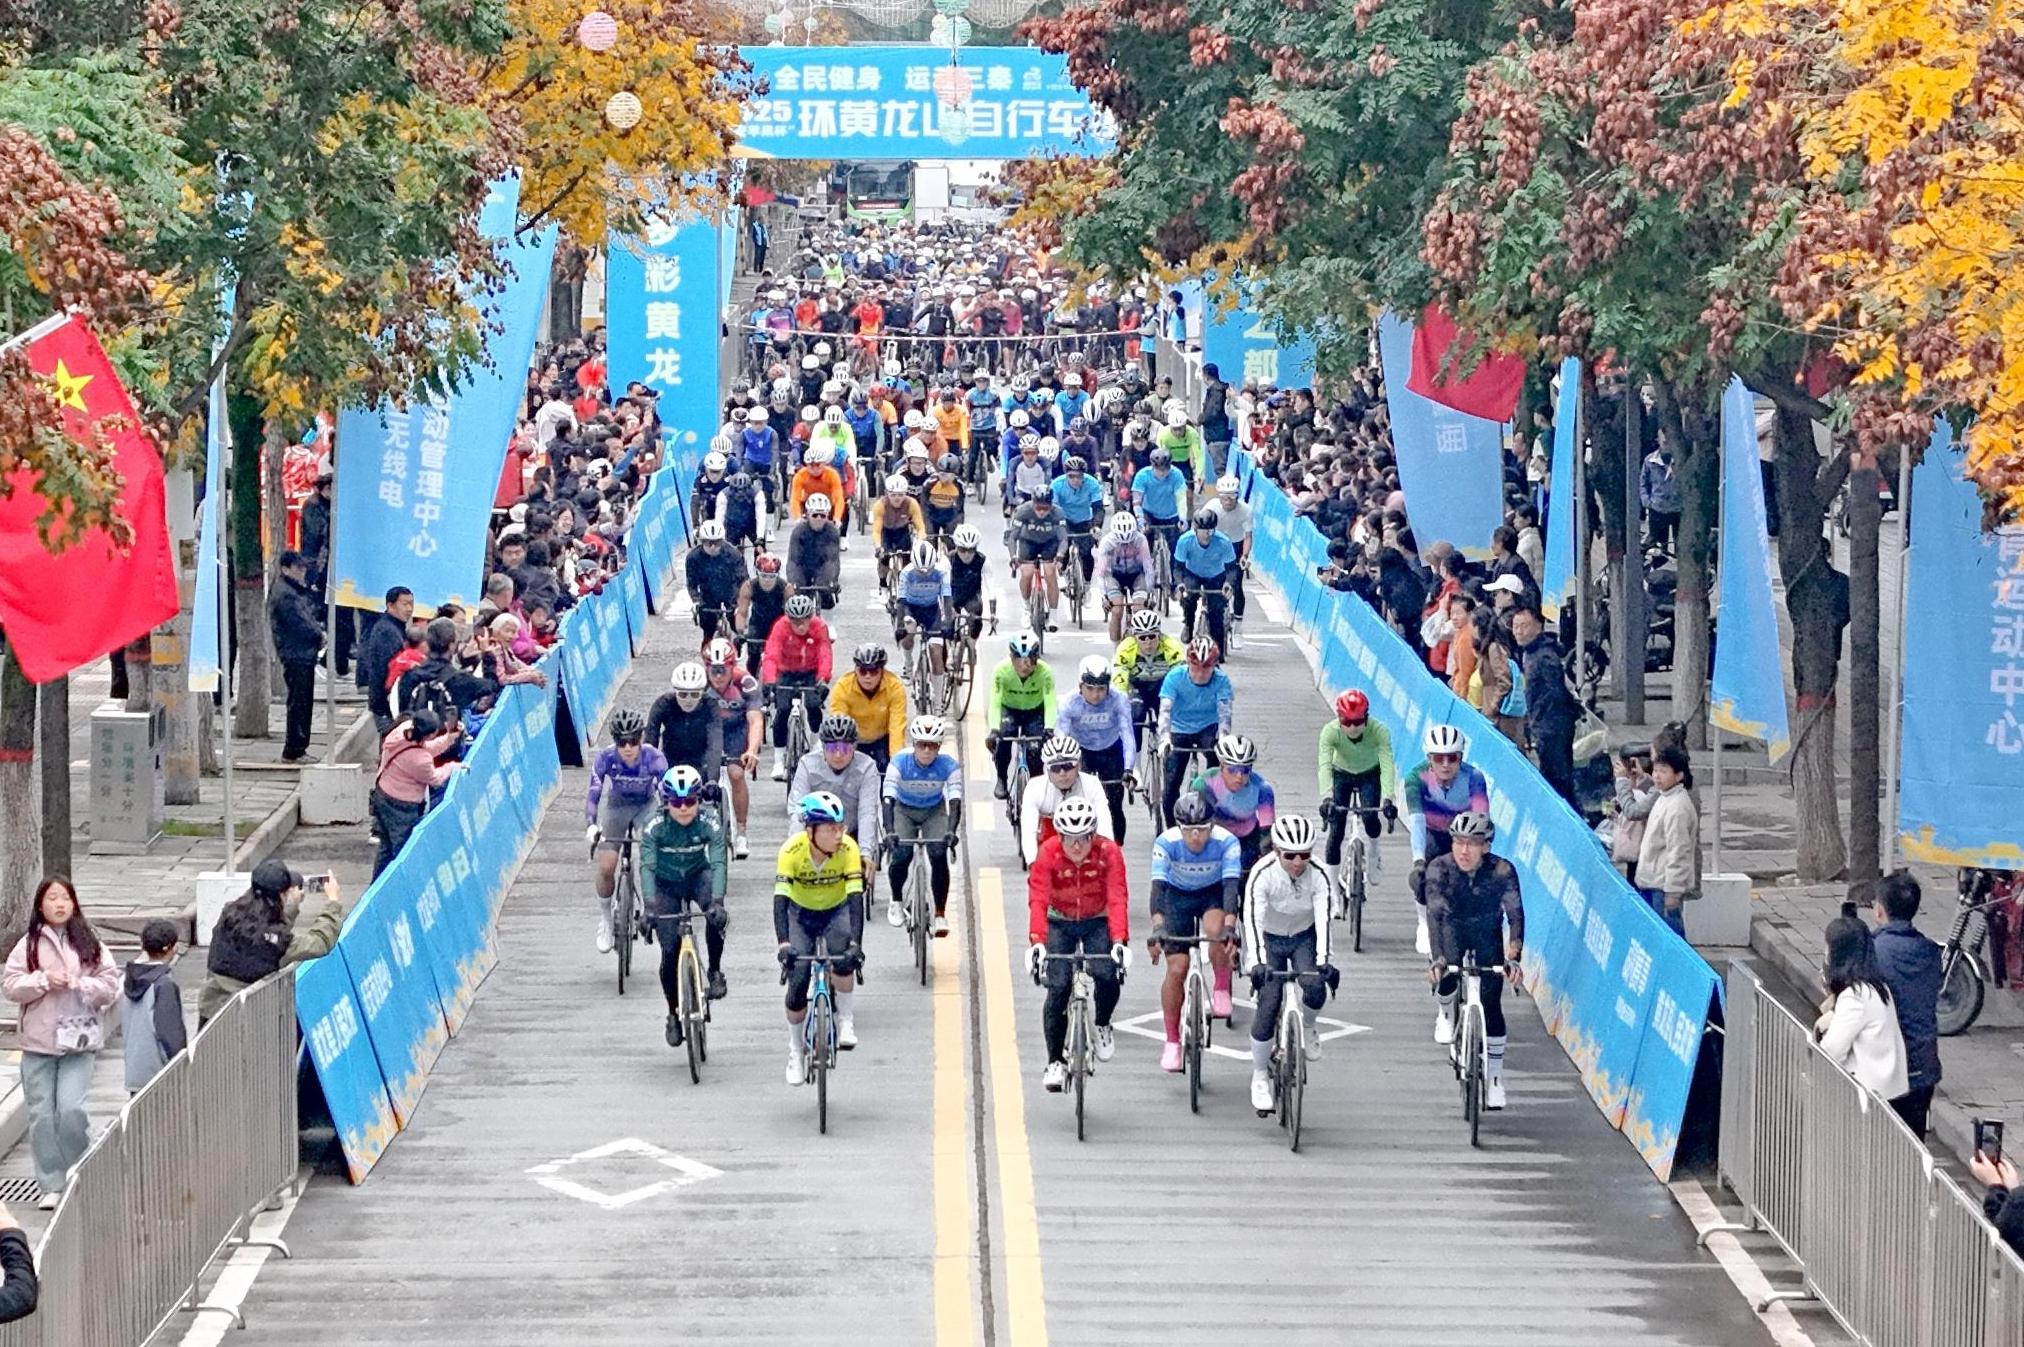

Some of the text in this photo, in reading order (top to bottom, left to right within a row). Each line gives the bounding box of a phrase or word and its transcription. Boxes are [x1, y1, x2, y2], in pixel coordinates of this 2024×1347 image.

[774, 65, 881, 91] 全民健身
[905, 65, 1013, 91] 运三秦
[798, 100, 1118, 139] 环黄龙山自行车
[1243, 280, 1279, 385] 之都
[378, 410, 411, 508] 无线电
[408, 392, 450, 558] 动管理中心
